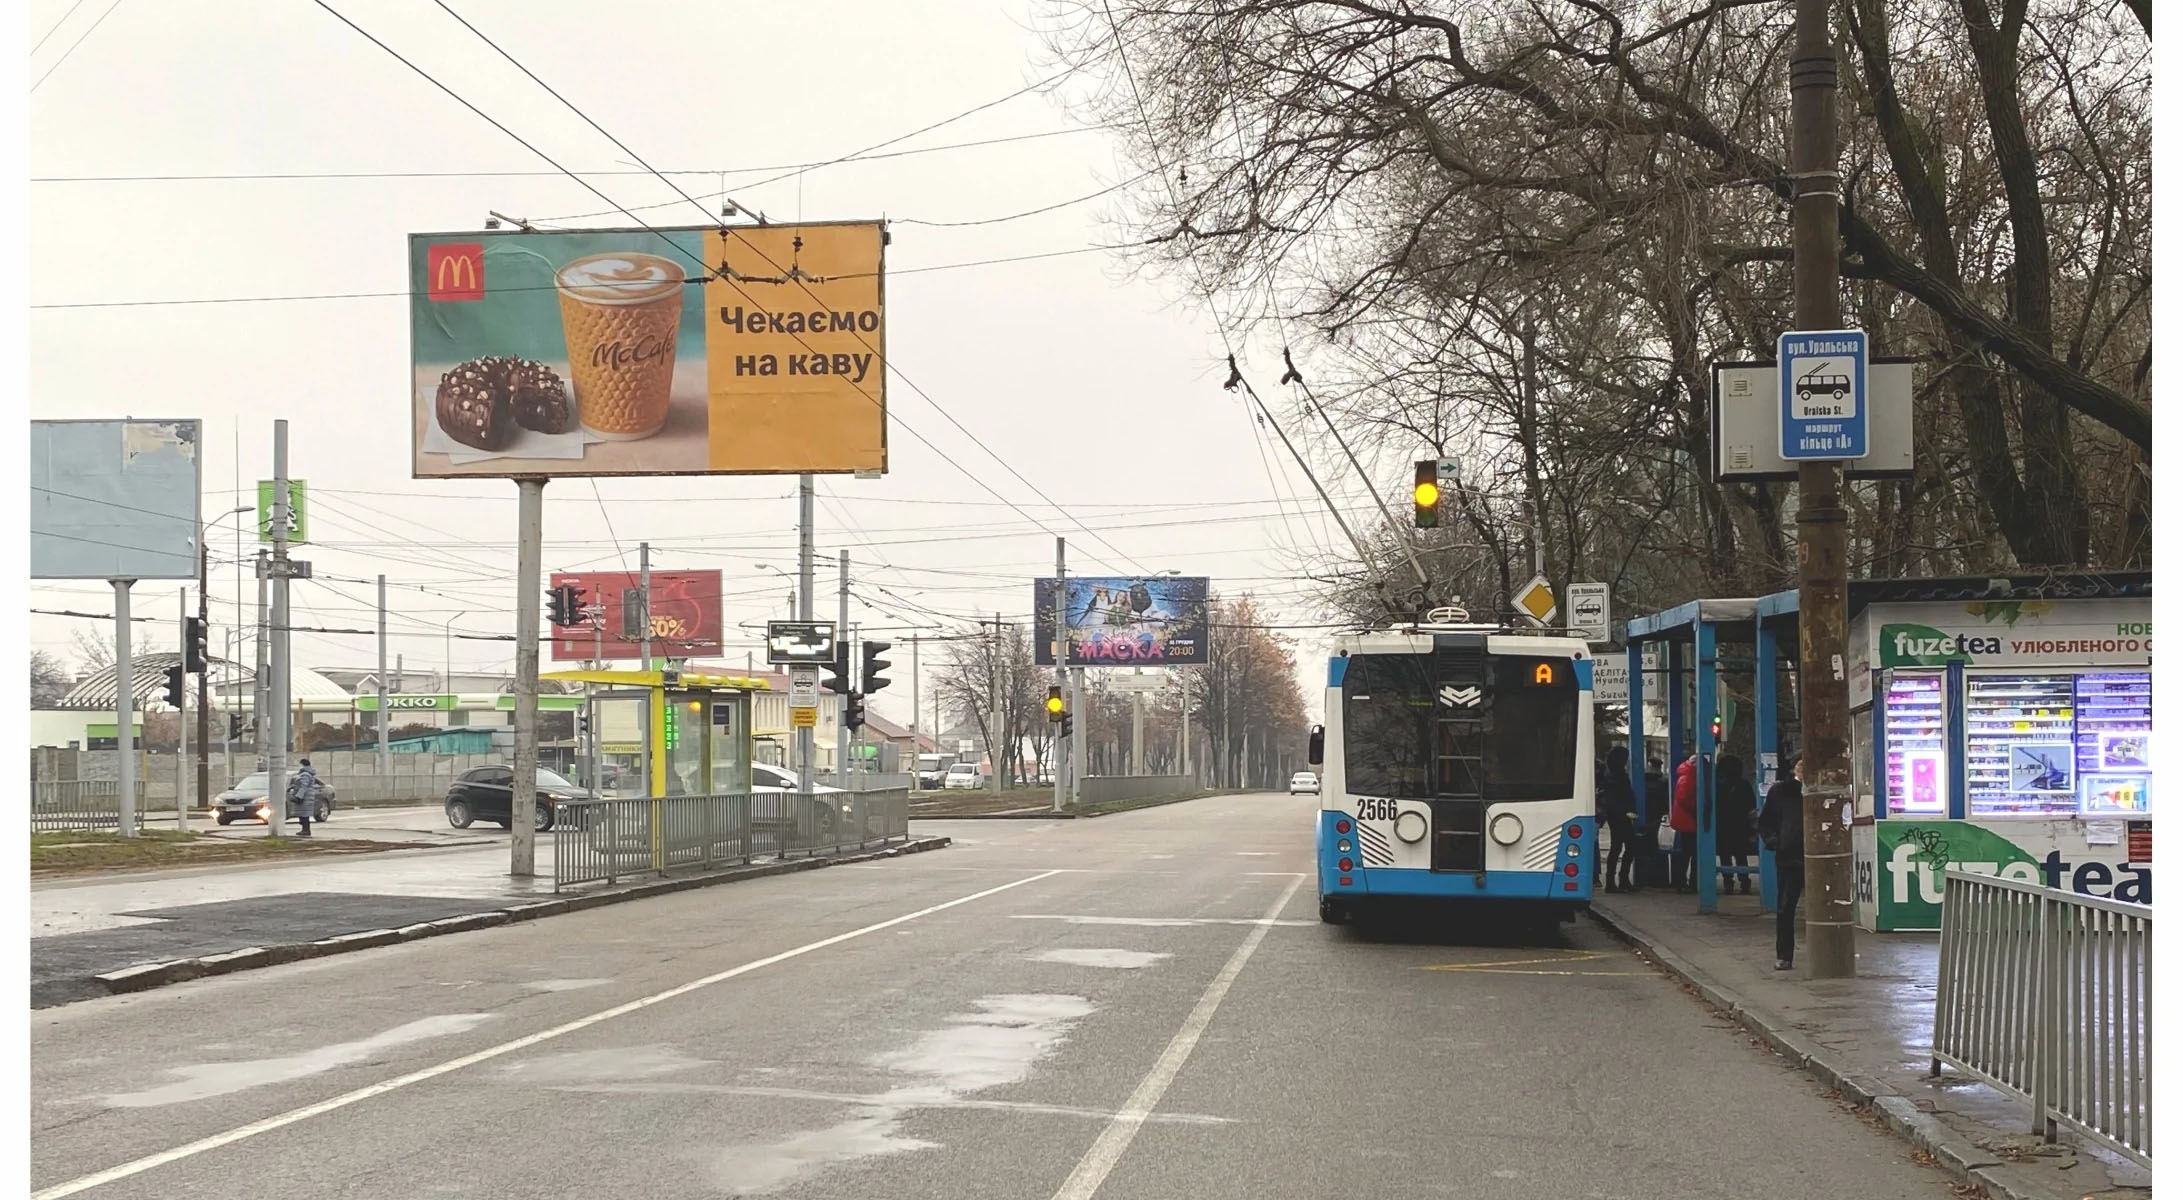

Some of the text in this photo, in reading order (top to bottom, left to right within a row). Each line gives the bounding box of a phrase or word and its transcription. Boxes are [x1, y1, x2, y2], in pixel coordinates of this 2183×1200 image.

[720, 306, 879, 334] Чекаємо
[1788, 340, 1858, 355] вул. Уральська
[736, 353, 873, 383] на каву
[1804, 405, 1844, 416] Uralska St.
[1805, 424, 1842, 433] маршрут
[1800, 436, 1833, 451] кільце
[1078, 641, 1164, 660] МАСКА
[1169, 647, 1194, 656] 20:00
[2011, 639, 2139, 654] УЛЮБЛЕНОГО
[1595, 677, 1627, 686] Hyund
[1357, 799, 1398, 821] 2566
